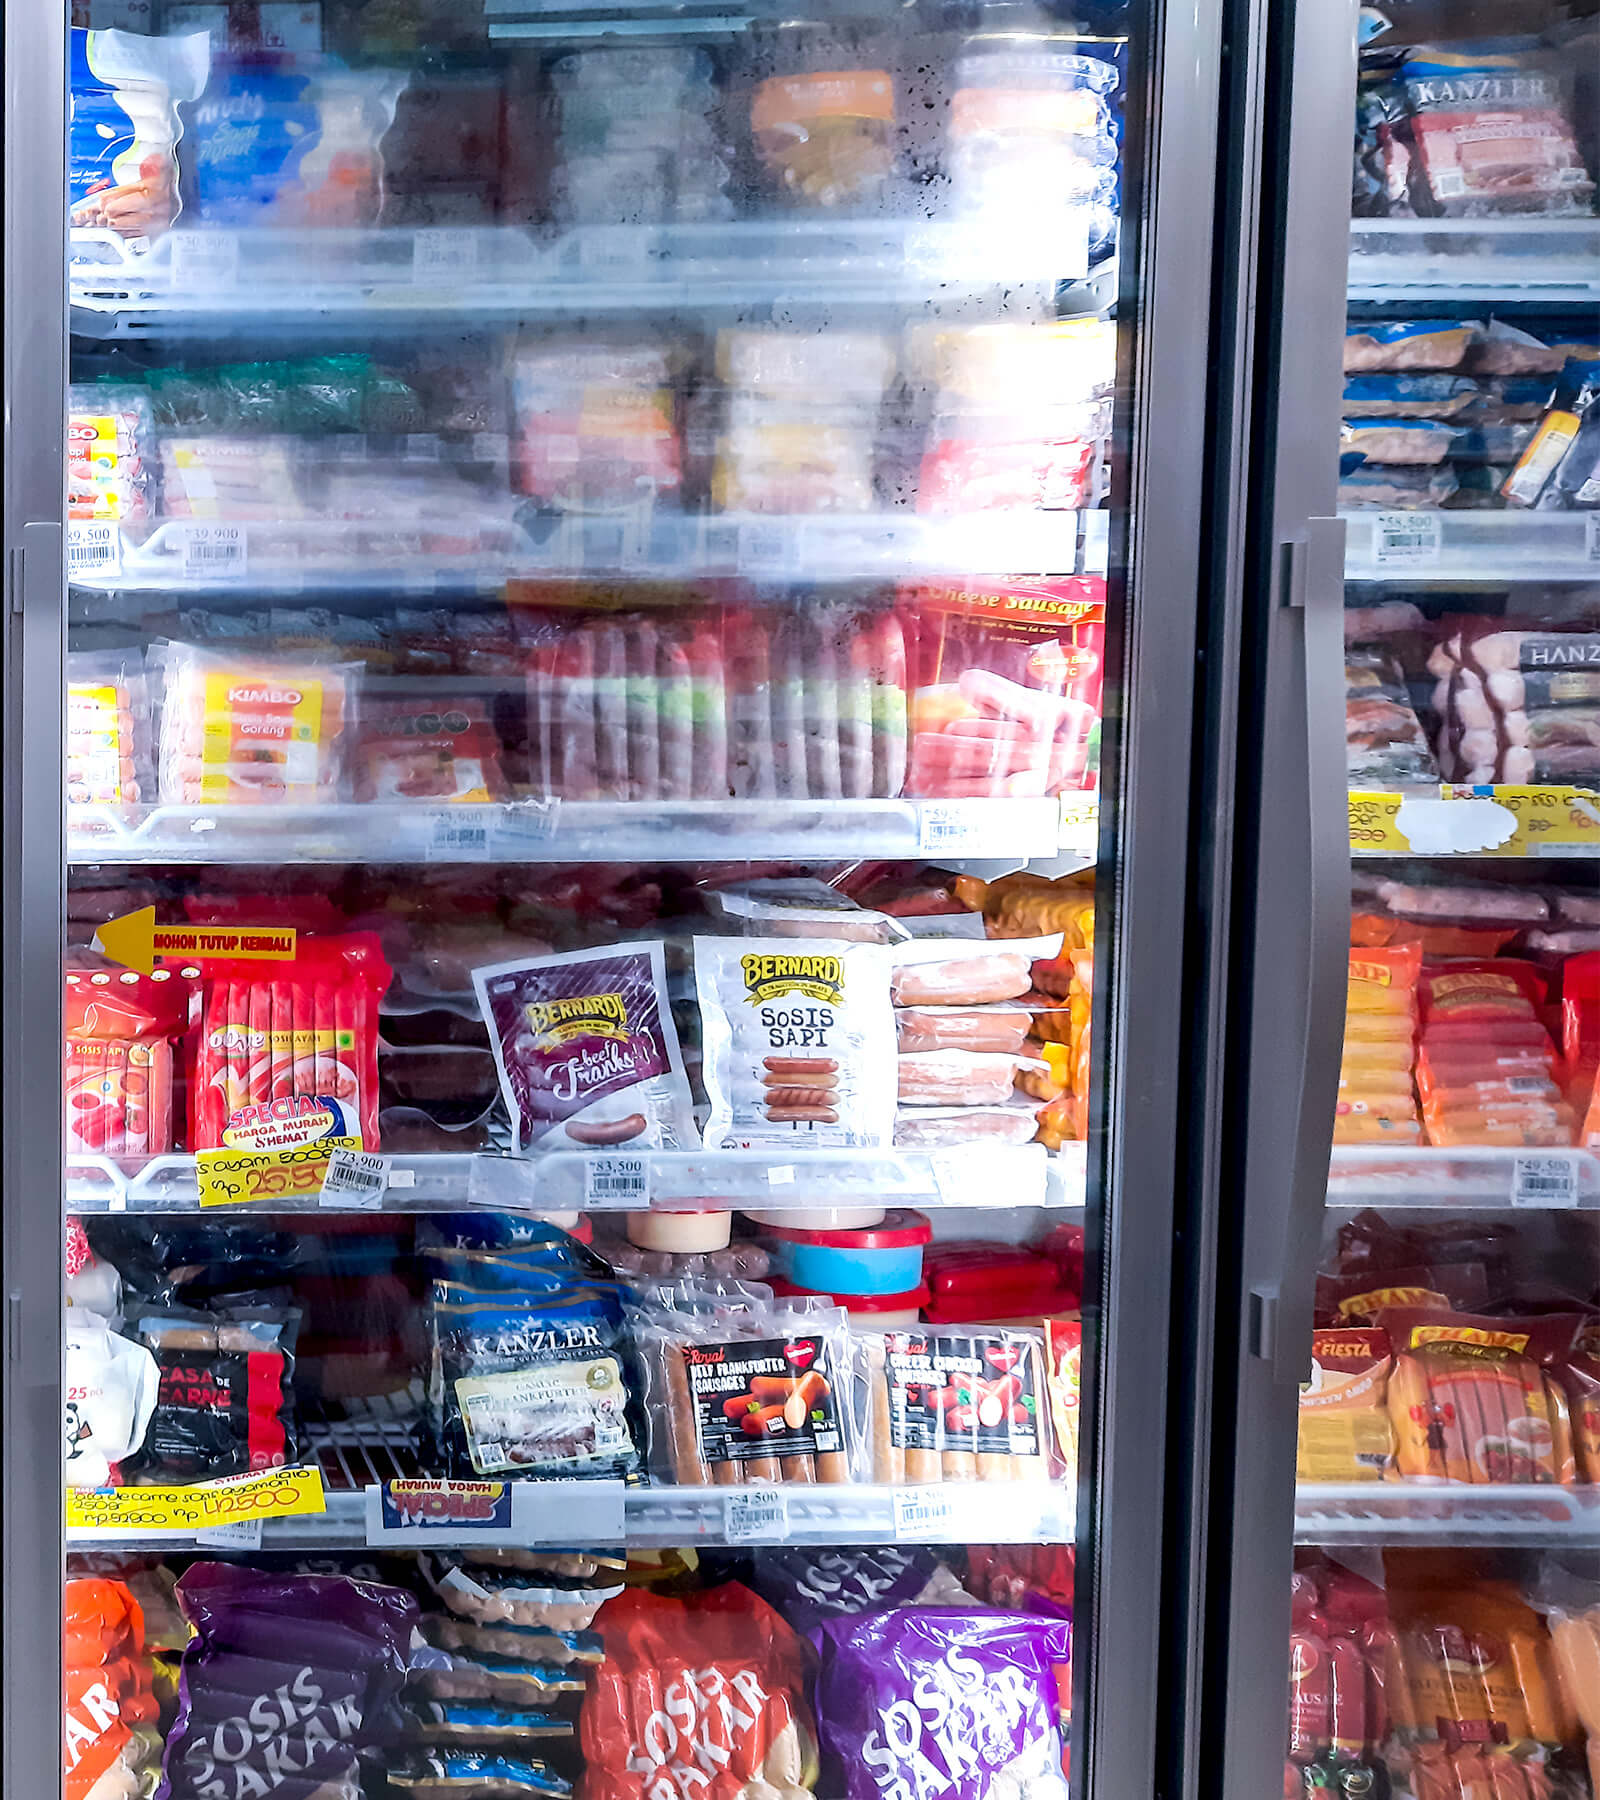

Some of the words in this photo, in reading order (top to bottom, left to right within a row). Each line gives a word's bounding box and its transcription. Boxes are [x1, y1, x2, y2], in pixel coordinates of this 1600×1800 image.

[1416, 78, 1545, 103] KANZLER
[1005, 595, 1094, 622] Sausage
[227, 688, 302, 705] KIMBO
[240, 724, 285, 737] Goreng
[154, 933, 197, 951] MOHON
[199, 935, 239, 951] TUTUP
[241, 935, 293, 953] KEMBALI
[525, 993, 628, 1036] BERNARDI
[768, 1027, 829, 1048] SAPI
[581, 1040, 611, 1066] beef
[228, 1096, 331, 1129] SPECIAL
[233, 1125, 277, 1140] HARGA
[283, 1116, 329, 1132] MURAH
[341, 1150, 384, 1171] 73,900
[596, 1160, 642, 1172] 83,500
[472, 1326, 602, 1356] KANZLER
[1321, 1343, 1373, 1358] FIESTA
[690, 1346, 725, 1365] Royal
[716, 1357, 787, 1377] FRANKFURTER
[216, 1376, 231, 1388] DE
[695, 1375, 746, 1393] SAUSAGES
[68, 1387, 87, 1400] 25
[396, 1480, 442, 1491] MURAH
[447, 1482, 492, 1493] HARGA
[184, 1666, 324, 1787] SOSIS
